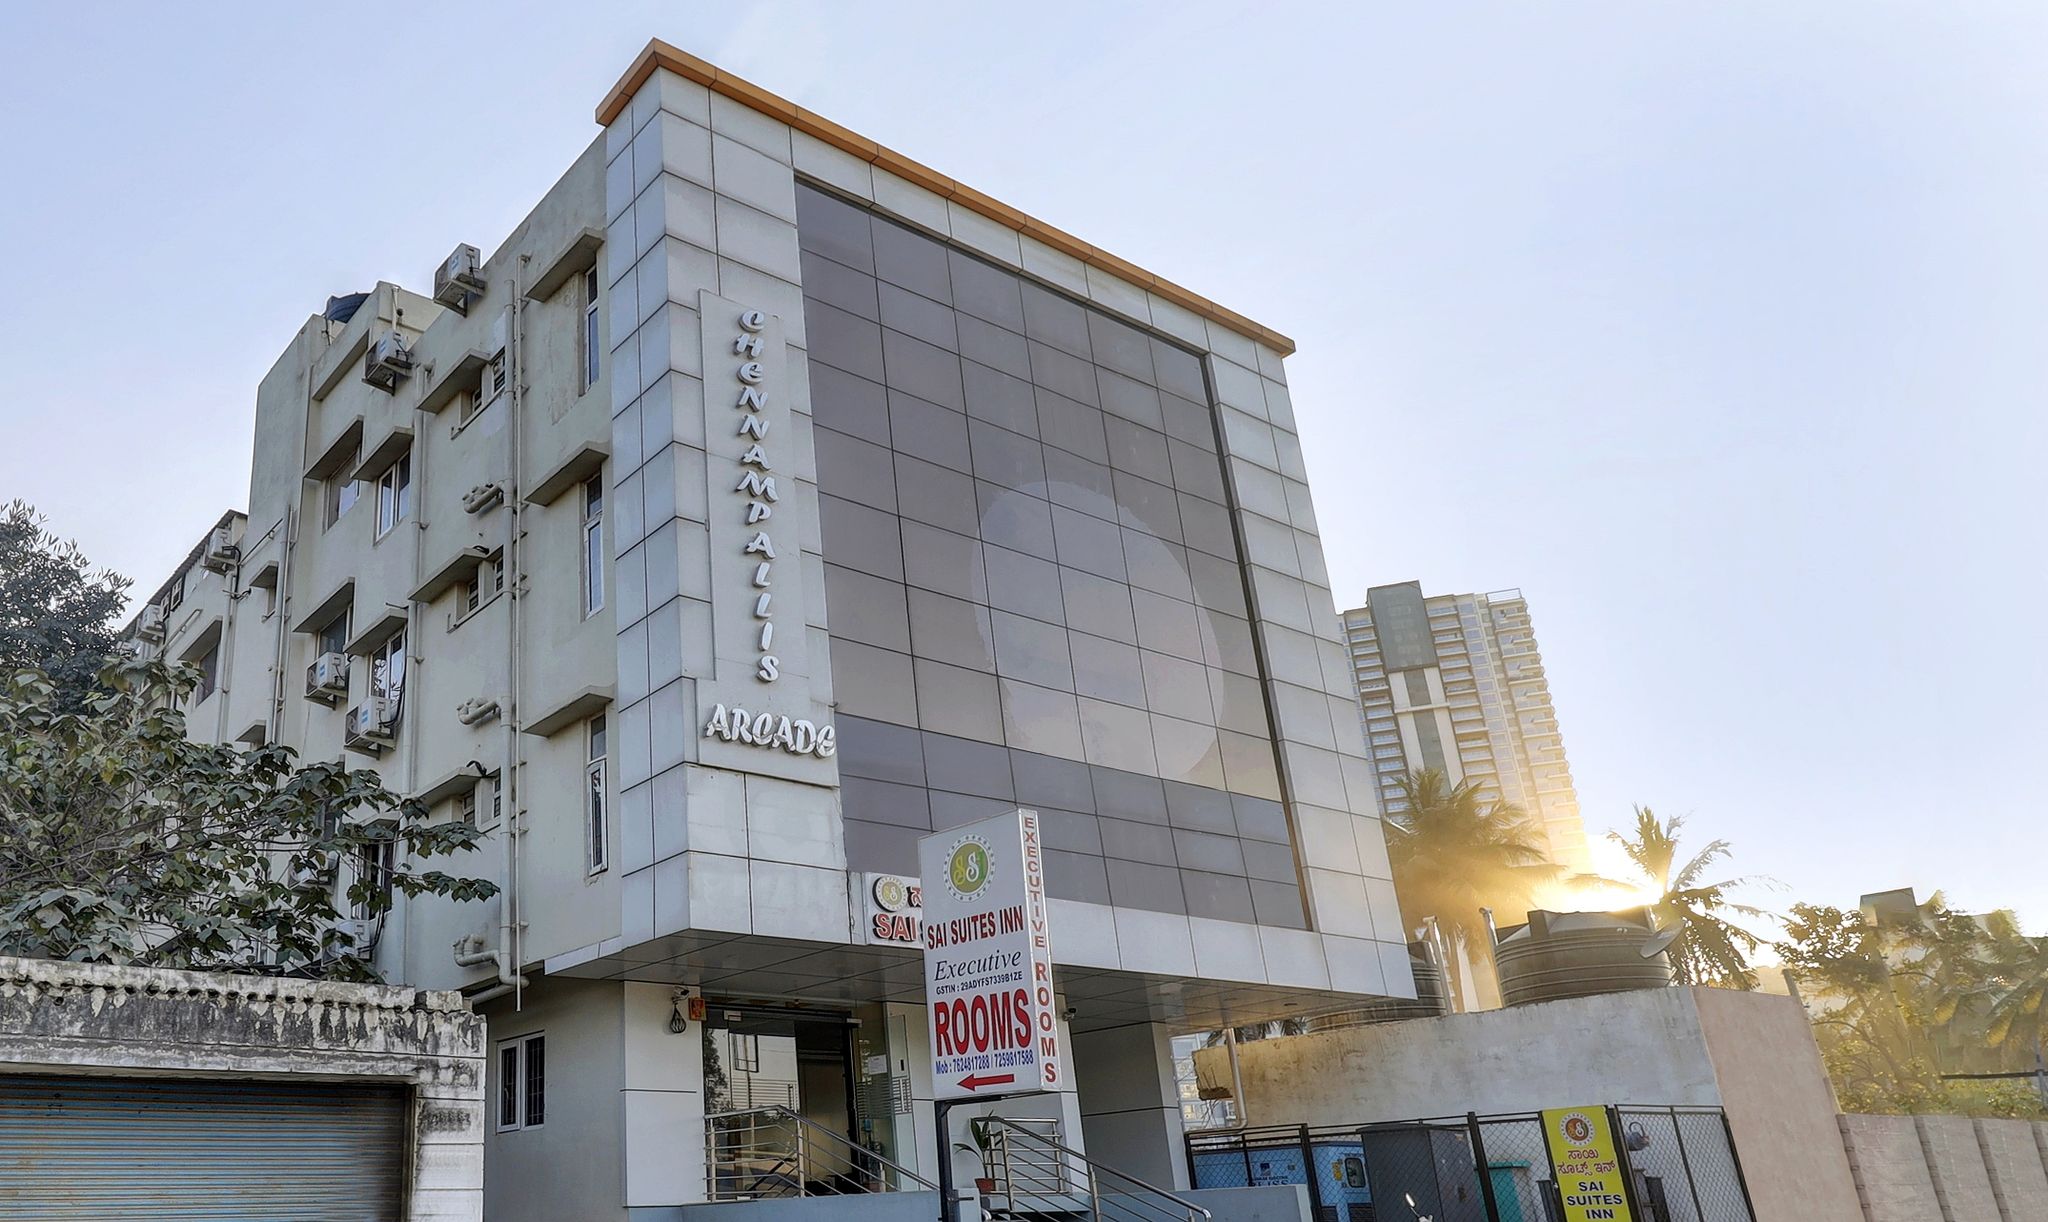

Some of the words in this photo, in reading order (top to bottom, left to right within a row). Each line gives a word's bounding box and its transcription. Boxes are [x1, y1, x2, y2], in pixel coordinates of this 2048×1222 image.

[735, 309, 779, 683] CHENNAMPALLIS
[705, 703, 836, 758] ARCADE
[1024, 816, 1046, 948] EXECUTIVE
[875, 913, 917, 941] SAI
[927, 922, 948, 950] SAI
[950, 911, 996, 945] SUITES
[999, 905, 1024, 935] INN
[934, 949, 1022, 982] Executive
[936, 984, 957, 995] GSTIN
[934, 988, 1032, 1057] ROOMS
[1035, 961, 1056, 1083] ROOMS
[936, 1060, 948, 1075] Mob
[1566, 1194, 1623, 1206] SUITES
[1578, 1181, 1604, 1192] SAI
[1585, 1208, 1614, 1220] INN
